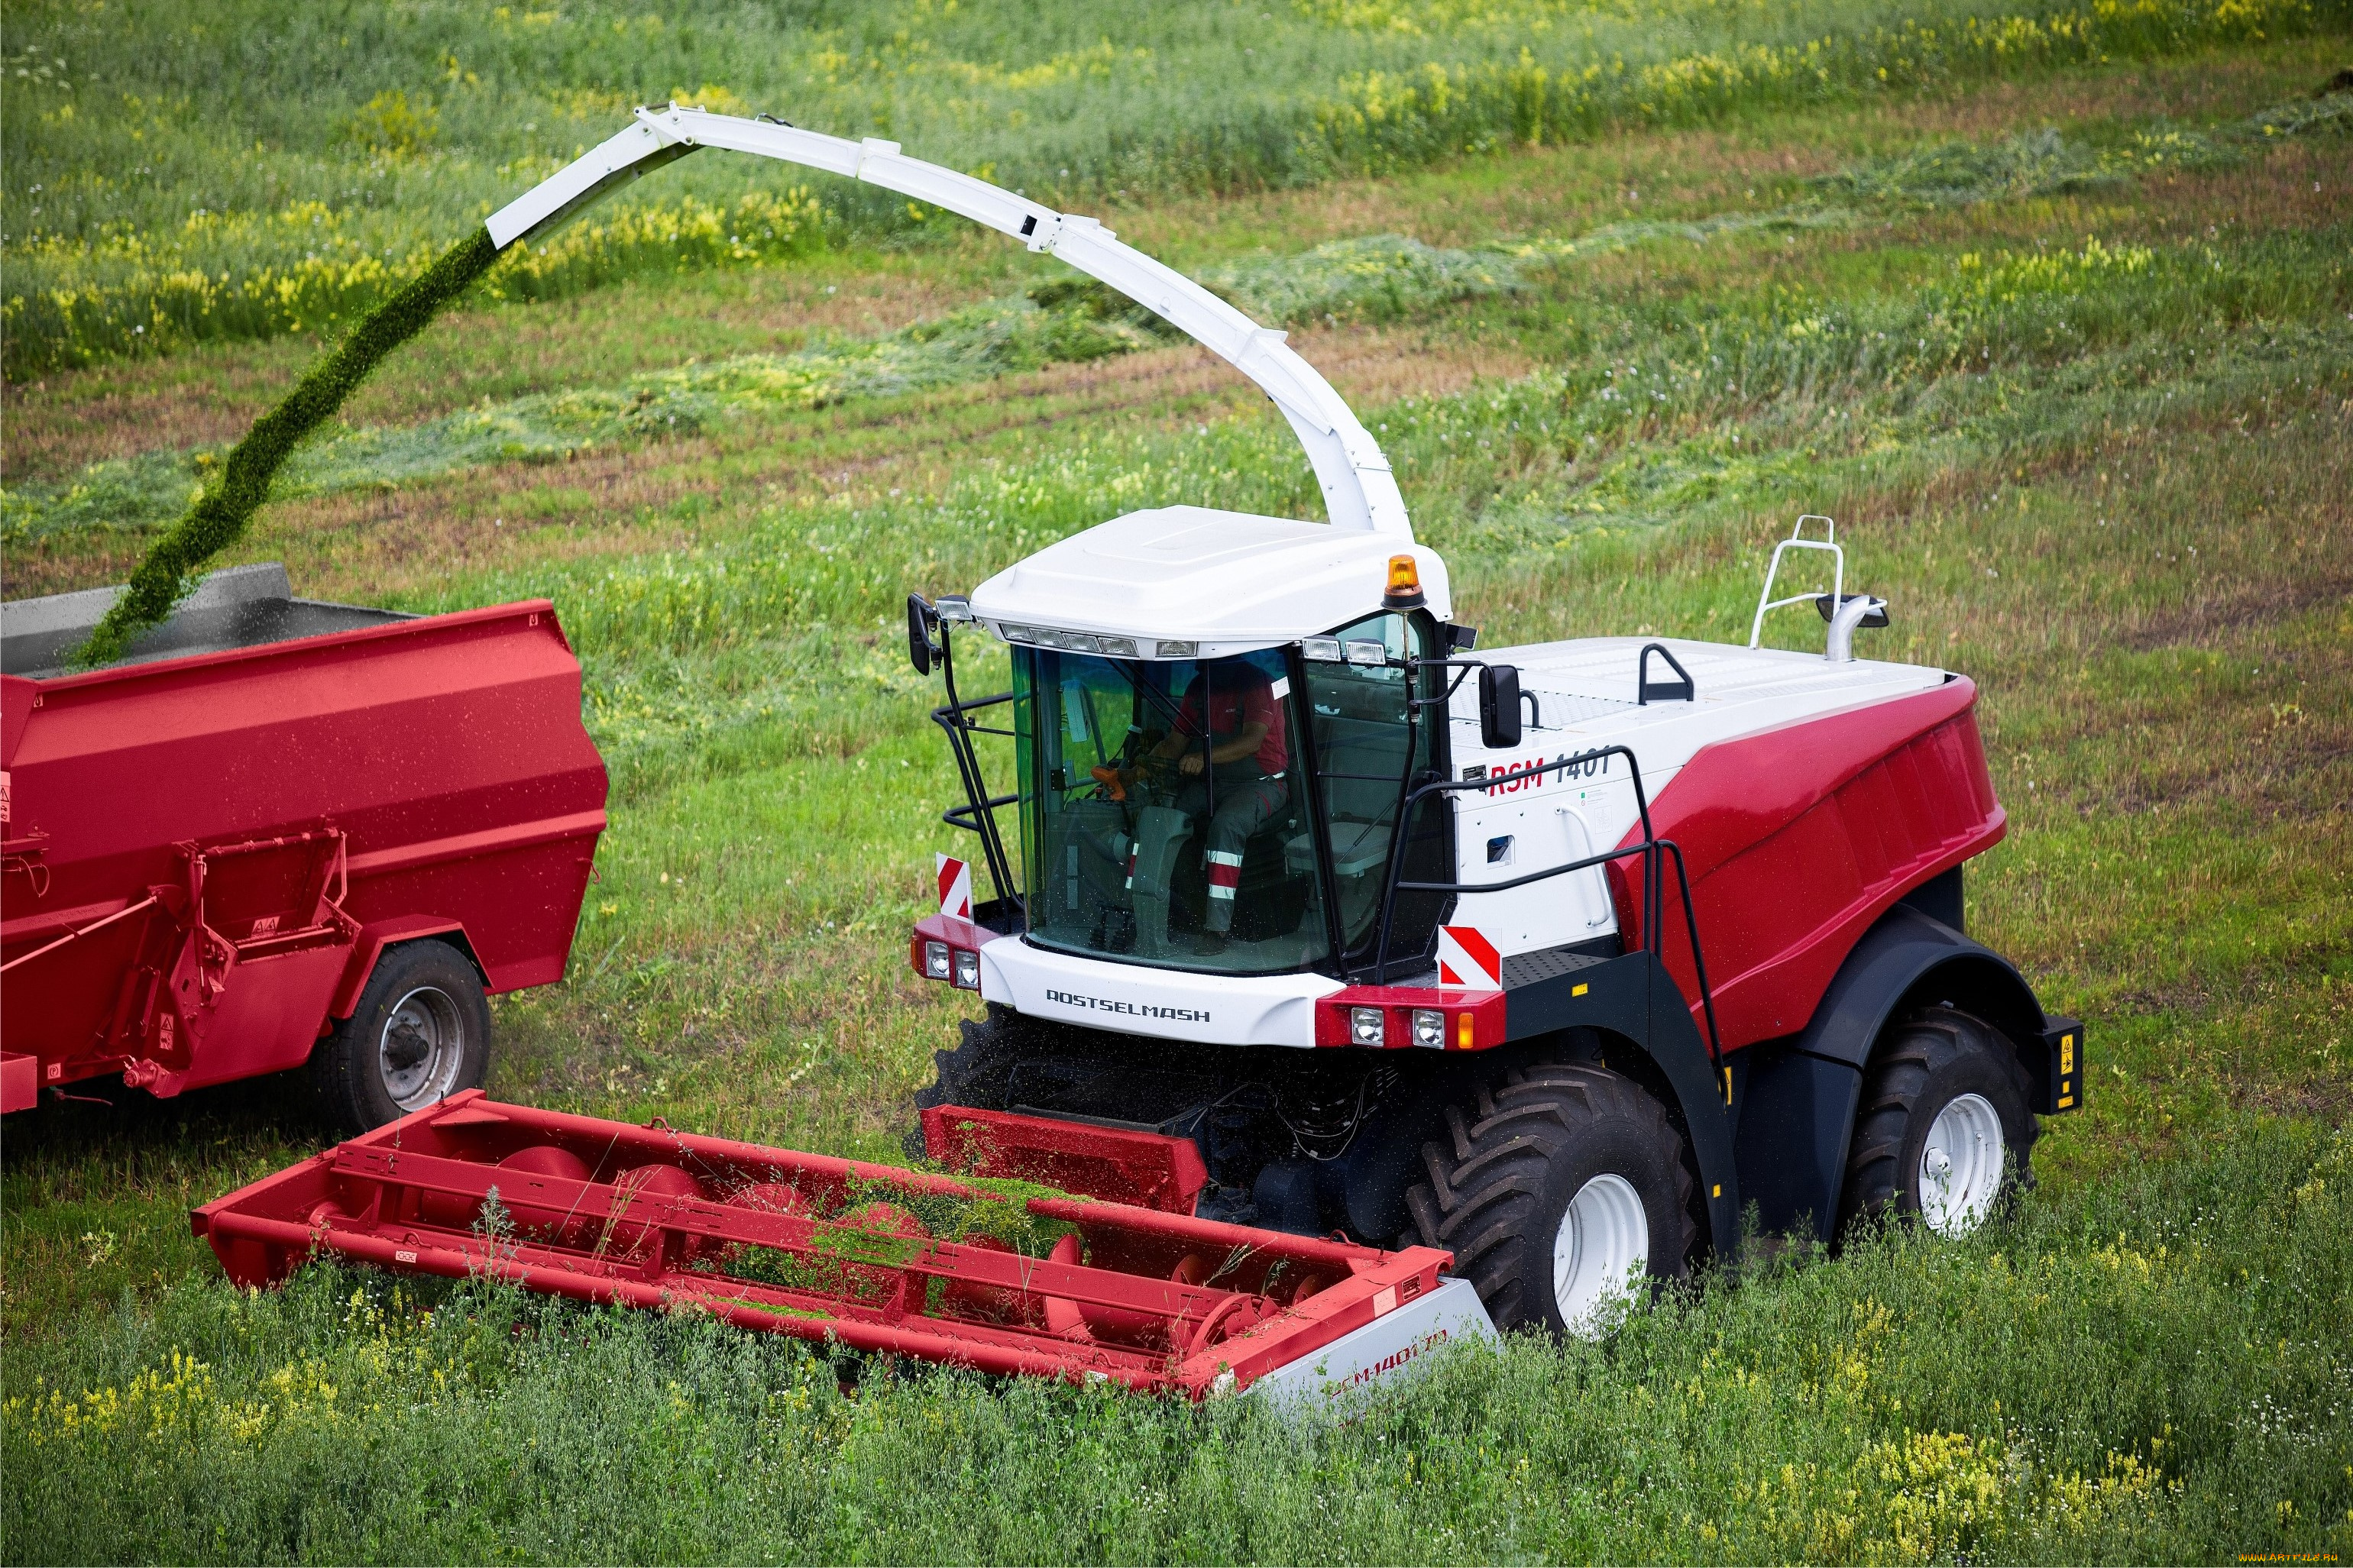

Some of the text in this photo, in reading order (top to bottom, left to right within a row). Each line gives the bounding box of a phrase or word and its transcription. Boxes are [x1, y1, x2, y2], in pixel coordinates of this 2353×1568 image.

[1490, 757, 1543, 797] RSM
[1556, 745, 1610, 784] 1401
[1046, 988, 1211, 1023] ROSTSELMASH
